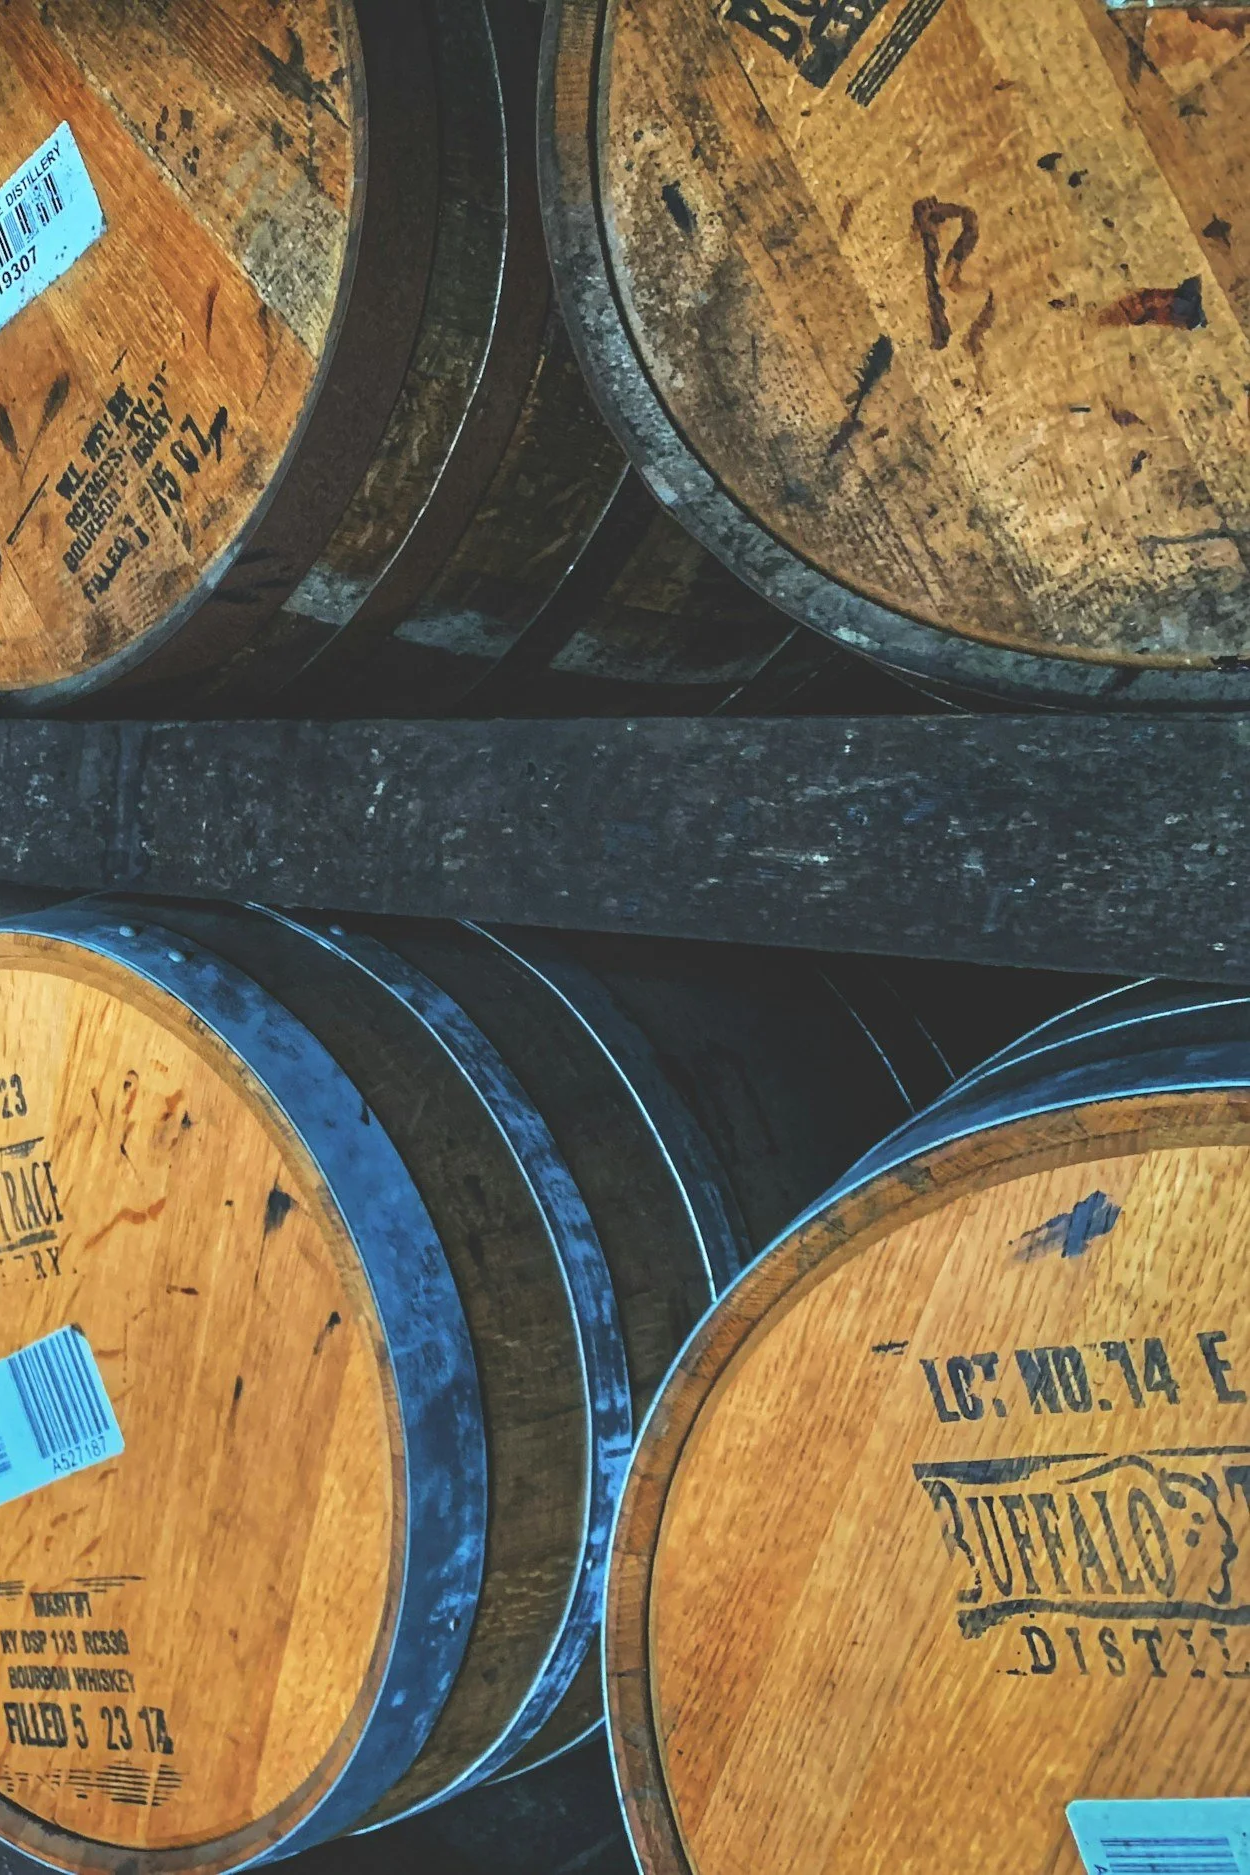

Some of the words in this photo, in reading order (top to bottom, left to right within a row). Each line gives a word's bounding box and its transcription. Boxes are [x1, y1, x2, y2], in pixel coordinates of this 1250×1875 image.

[5, 140, 63, 207] DISTILLERY
[1196, 1330, 1247, 1405] E
[52, 1436, 108, 1474] A527187
[921, 1479, 1176, 1604] BUFFALO
[0, 1629, 17, 1655] KY
[21, 1629, 47, 1655] DSP
[7, 1665, 72, 1691] BOURBON
[72, 1667, 136, 1693] WHISKEY
[3, 1701, 68, 1749] FILLED
[70, 1703, 89, 1750] 5
[100, 1704, 133, 1751] 23
